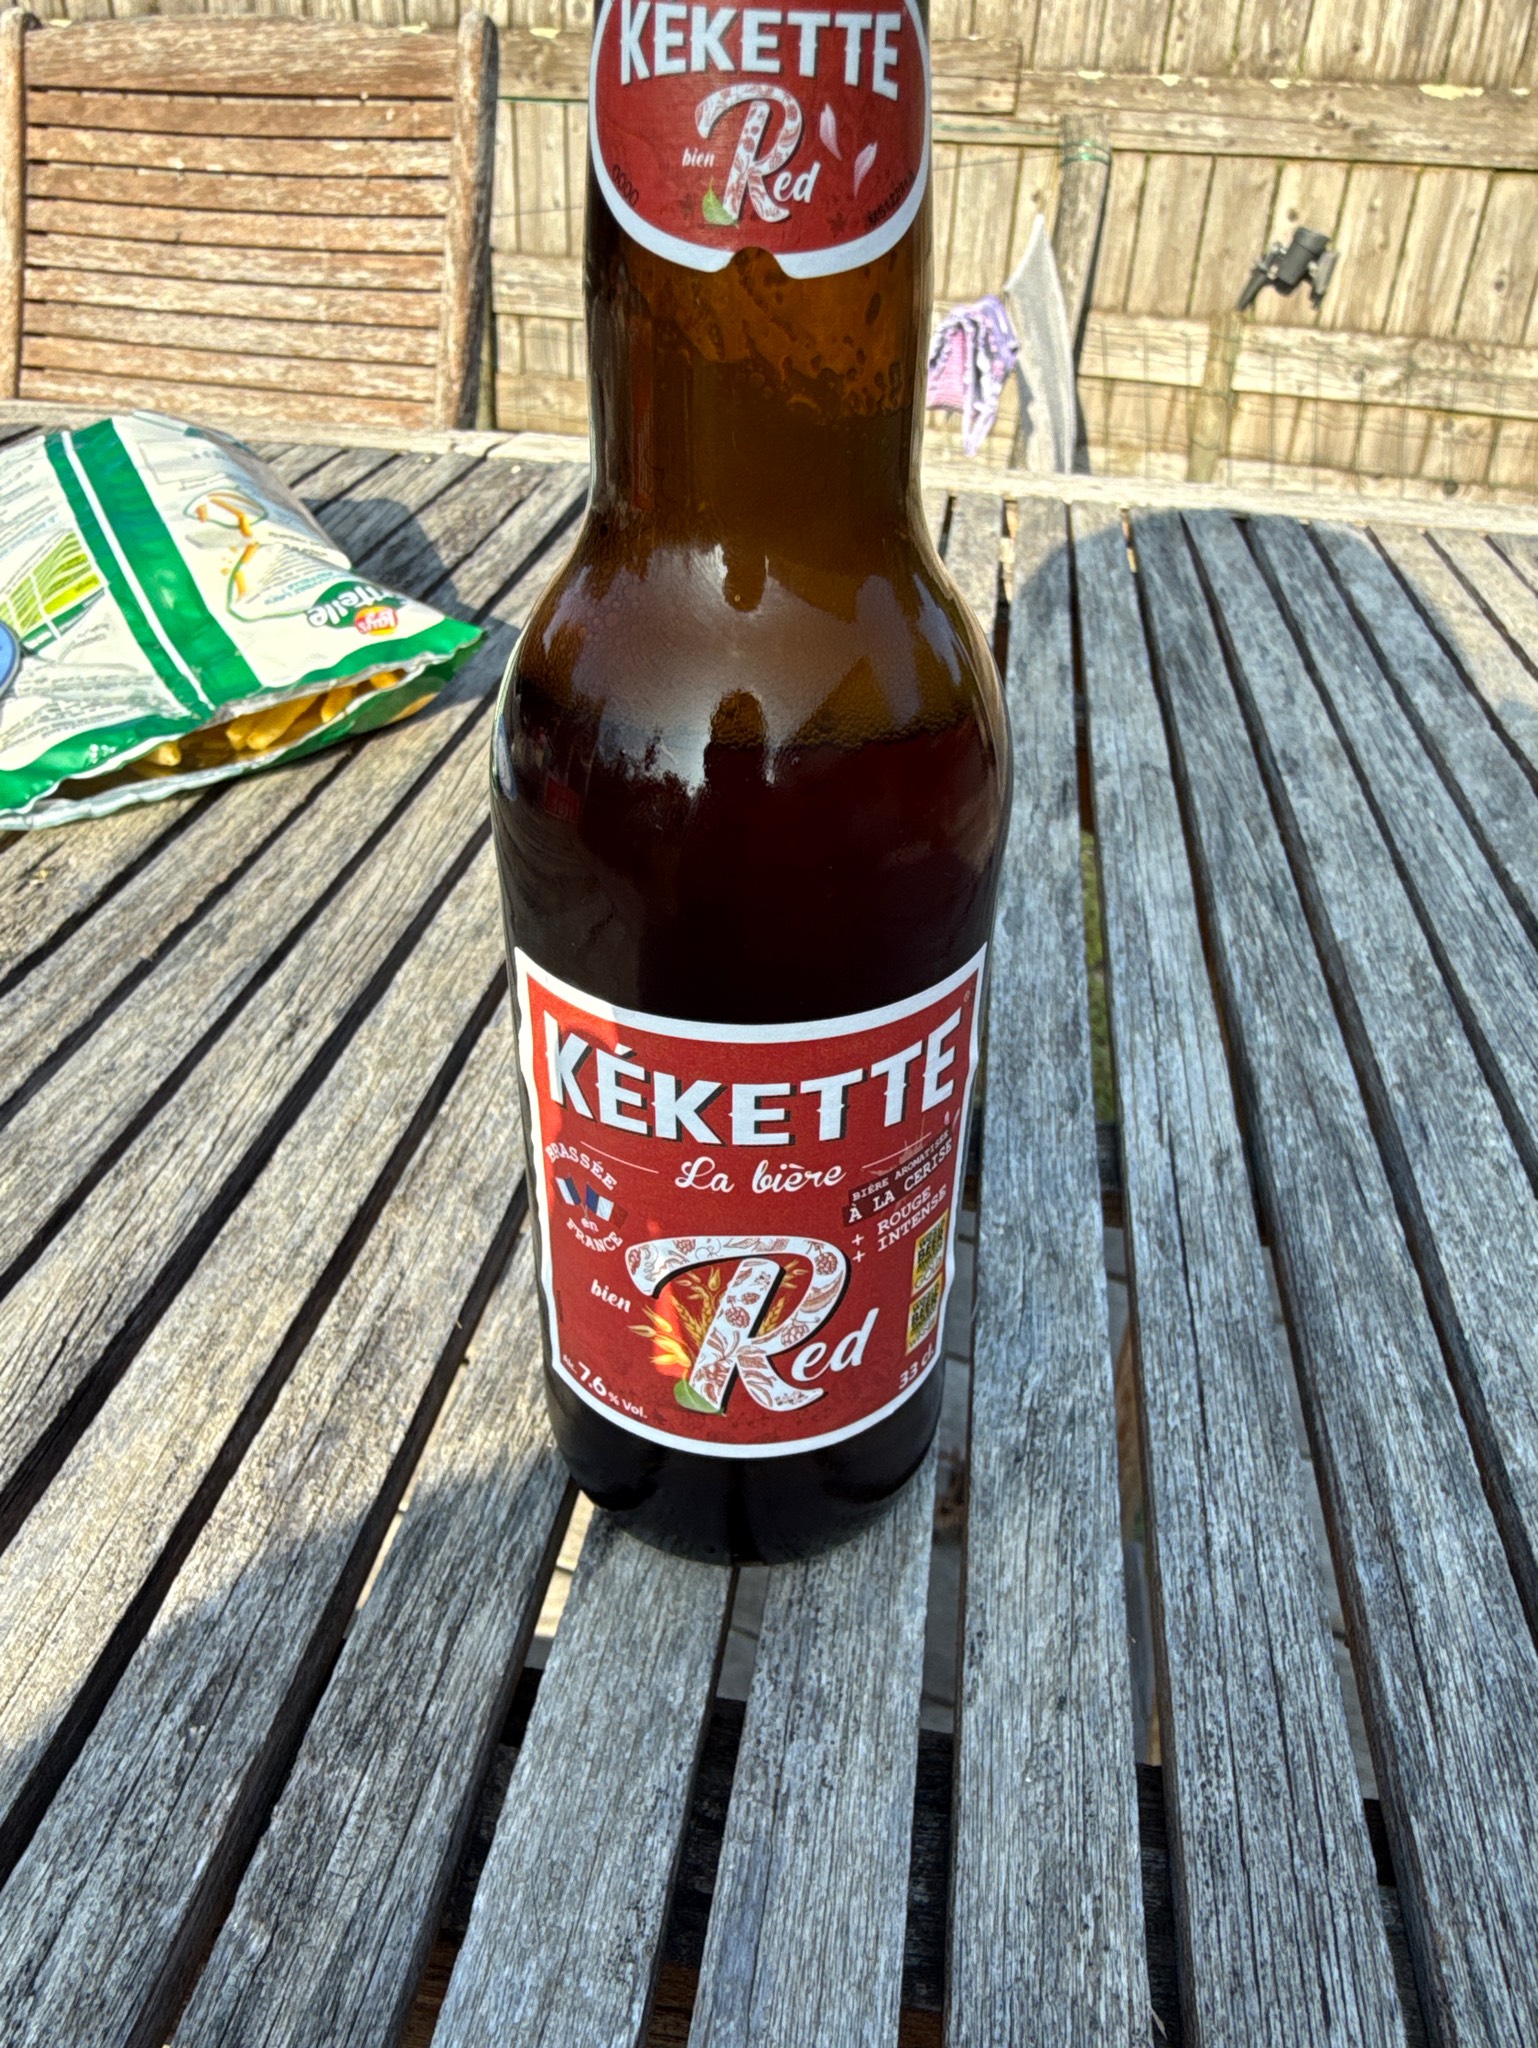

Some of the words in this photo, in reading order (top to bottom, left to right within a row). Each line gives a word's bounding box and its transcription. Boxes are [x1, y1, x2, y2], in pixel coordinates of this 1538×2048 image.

[682, 147, 715, 168] bien
[695, 82, 821, 224] Red
[357, 608, 396, 634] Lay's
[543, 1006, 964, 1147] KÉKETTE
[545, 1142, 618, 1191] BRASSÉE
[674, 1156, 735, 1193] La
[751, 1160, 847, 1194] bière
[848, 1203, 863, 1223] À
[872, 1190, 896, 1212] LA
[904, 1138, 953, 1192] CERISE
[566, 1217, 624, 1253] FRANCE
[581, 1217, 599, 1234] en
[877, 1185, 931, 1236] ROUGE
[877, 1184, 947, 1252] INTENSE
[590, 1279, 632, 1313] bien
[625, 1235, 880, 1413] Red
[898, 1361, 920, 1391] 33
